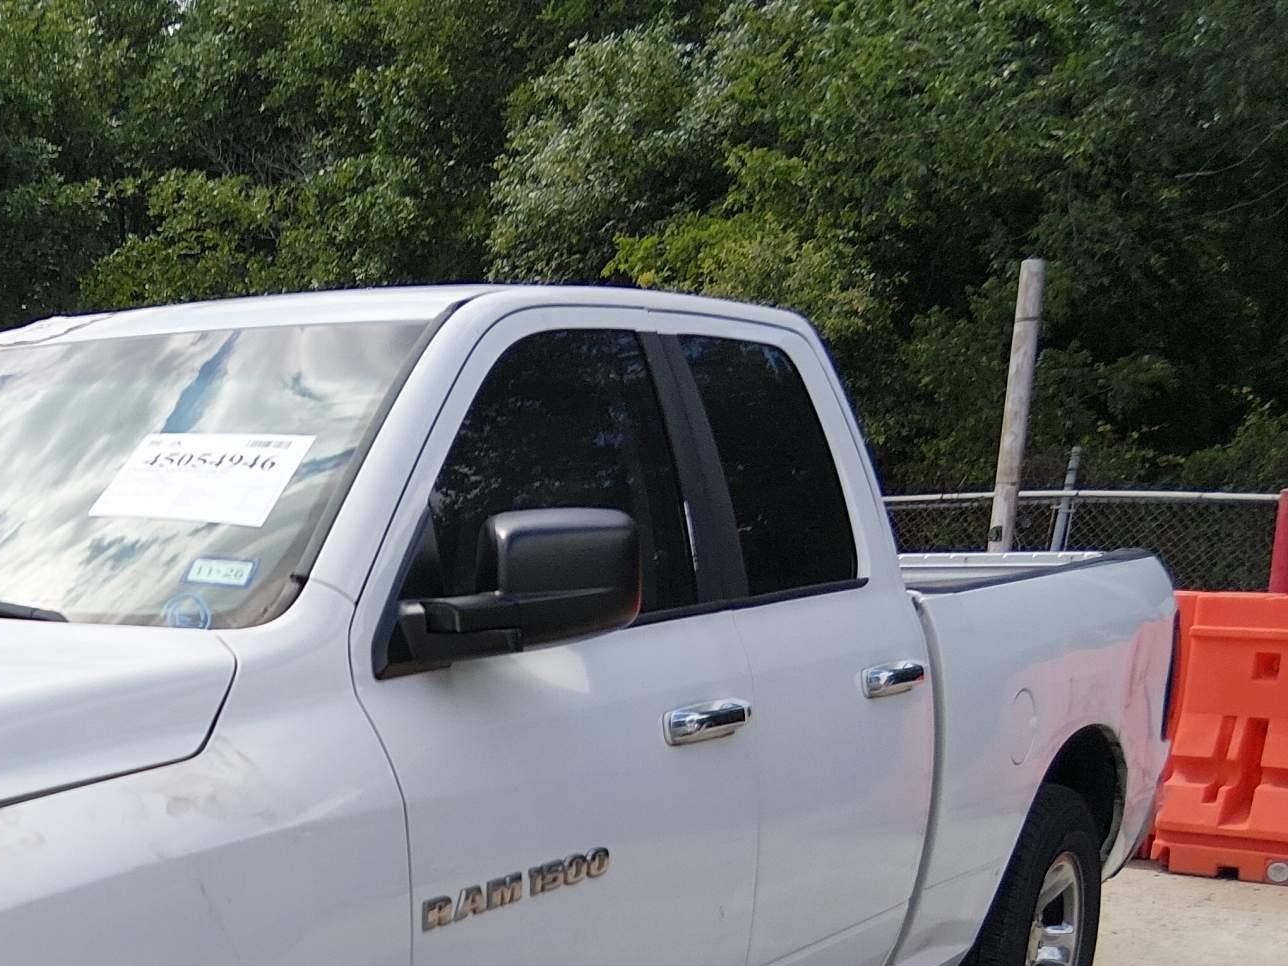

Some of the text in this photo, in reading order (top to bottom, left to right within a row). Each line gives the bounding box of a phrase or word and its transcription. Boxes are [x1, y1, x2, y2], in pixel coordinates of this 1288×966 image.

[144, 452, 280, 472] 45054946
[422, 846, 610, 933] RAM 1500
